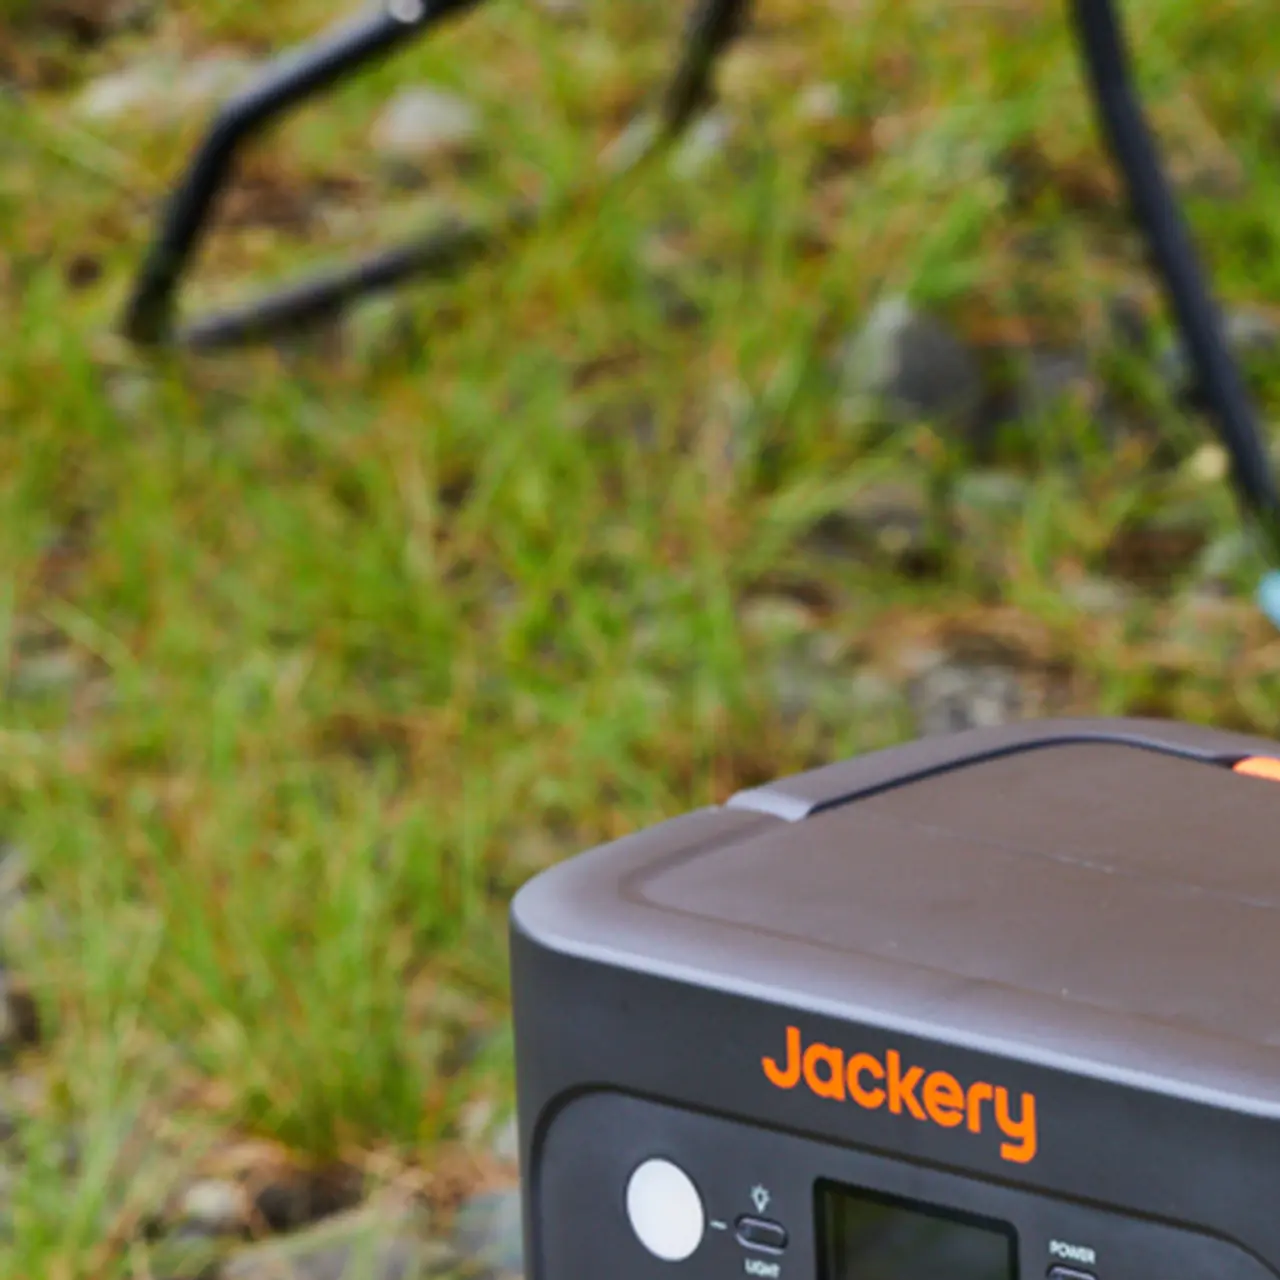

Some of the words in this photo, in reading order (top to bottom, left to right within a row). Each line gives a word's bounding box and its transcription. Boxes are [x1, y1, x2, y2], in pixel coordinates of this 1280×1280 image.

[761, 1026, 1037, 1163] Jackery
[1049, 1240, 1096, 1265] POWER
[745, 1258, 781, 1280] LIGHT
